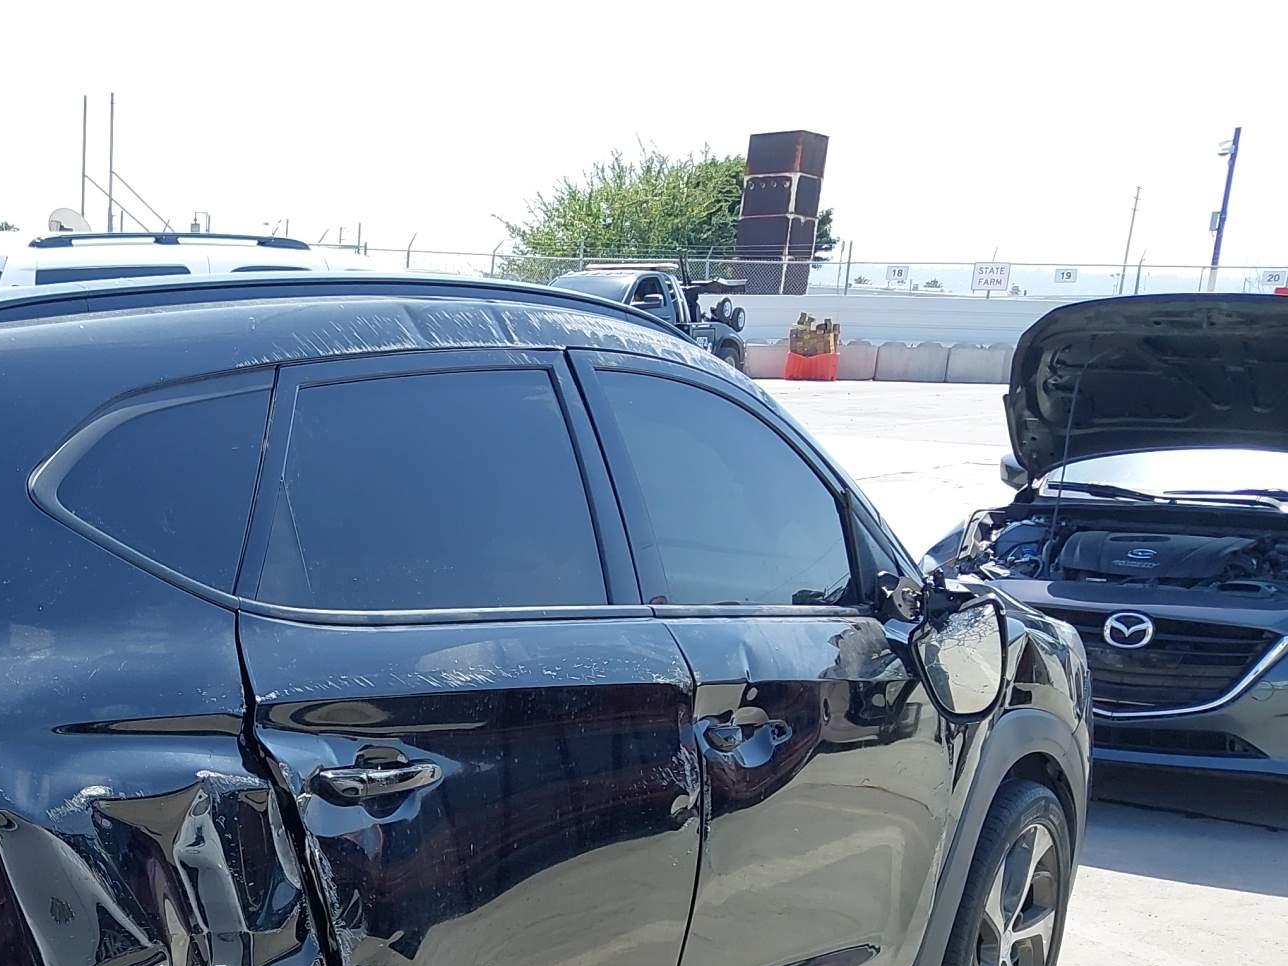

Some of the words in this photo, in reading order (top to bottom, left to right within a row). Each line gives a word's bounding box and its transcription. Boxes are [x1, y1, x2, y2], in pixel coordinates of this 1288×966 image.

[892, 268, 904, 278] 18
[978, 266, 1006, 275] STATE
[1060, 271, 1072, 280] 19
[1266, 273, 1281, 283] 20
[977, 278, 1003, 286] FARM
